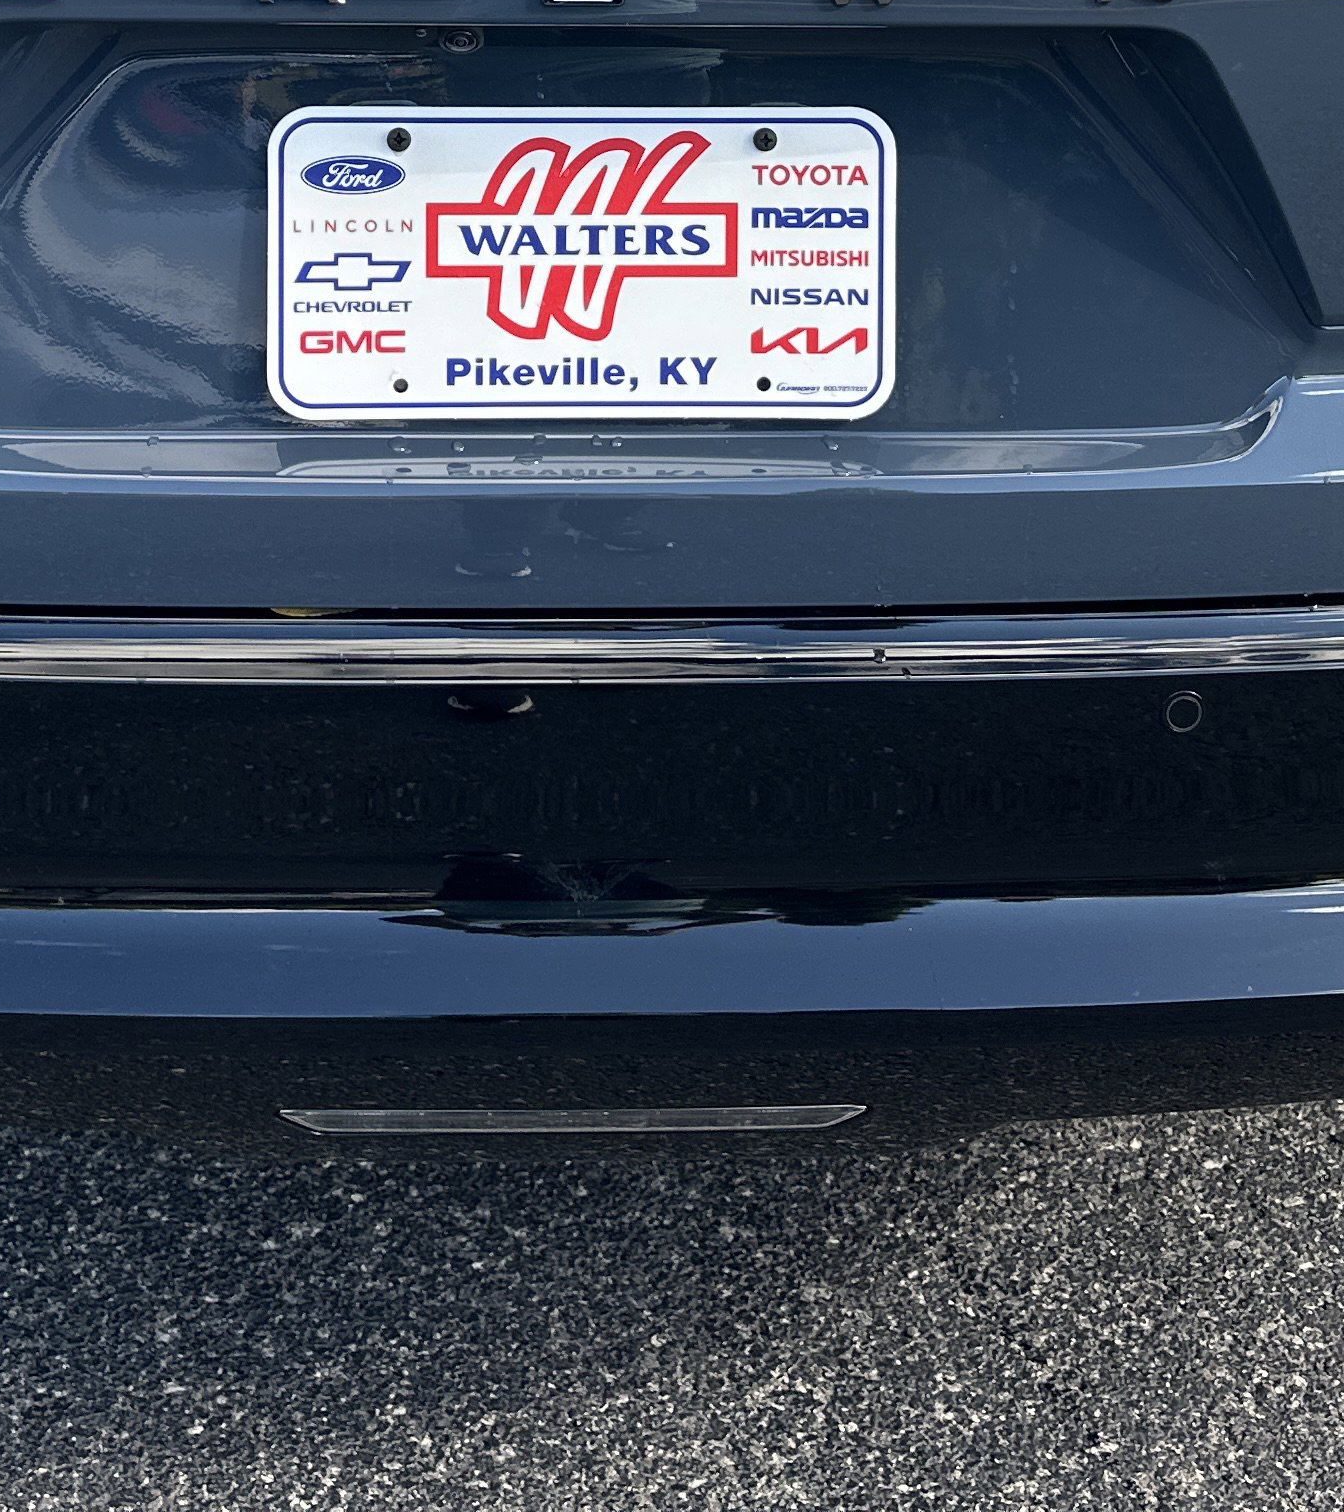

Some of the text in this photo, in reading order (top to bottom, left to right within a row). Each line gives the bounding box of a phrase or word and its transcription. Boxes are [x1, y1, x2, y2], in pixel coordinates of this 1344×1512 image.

[751, 164, 869, 186] TOYOTA
[292, 219, 414, 233] LINCOLN
[457, 224, 711, 256] WALTERS
[750, 249, 870, 267] MITSUBISHI
[293, 300, 413, 313] CHEVROLET
[750, 287, 869, 306] NISSAN
[300, 330, 406, 354] GMC
[750, 326, 868, 355] KIA
[445, 356, 718, 392] Pikeville, KY
